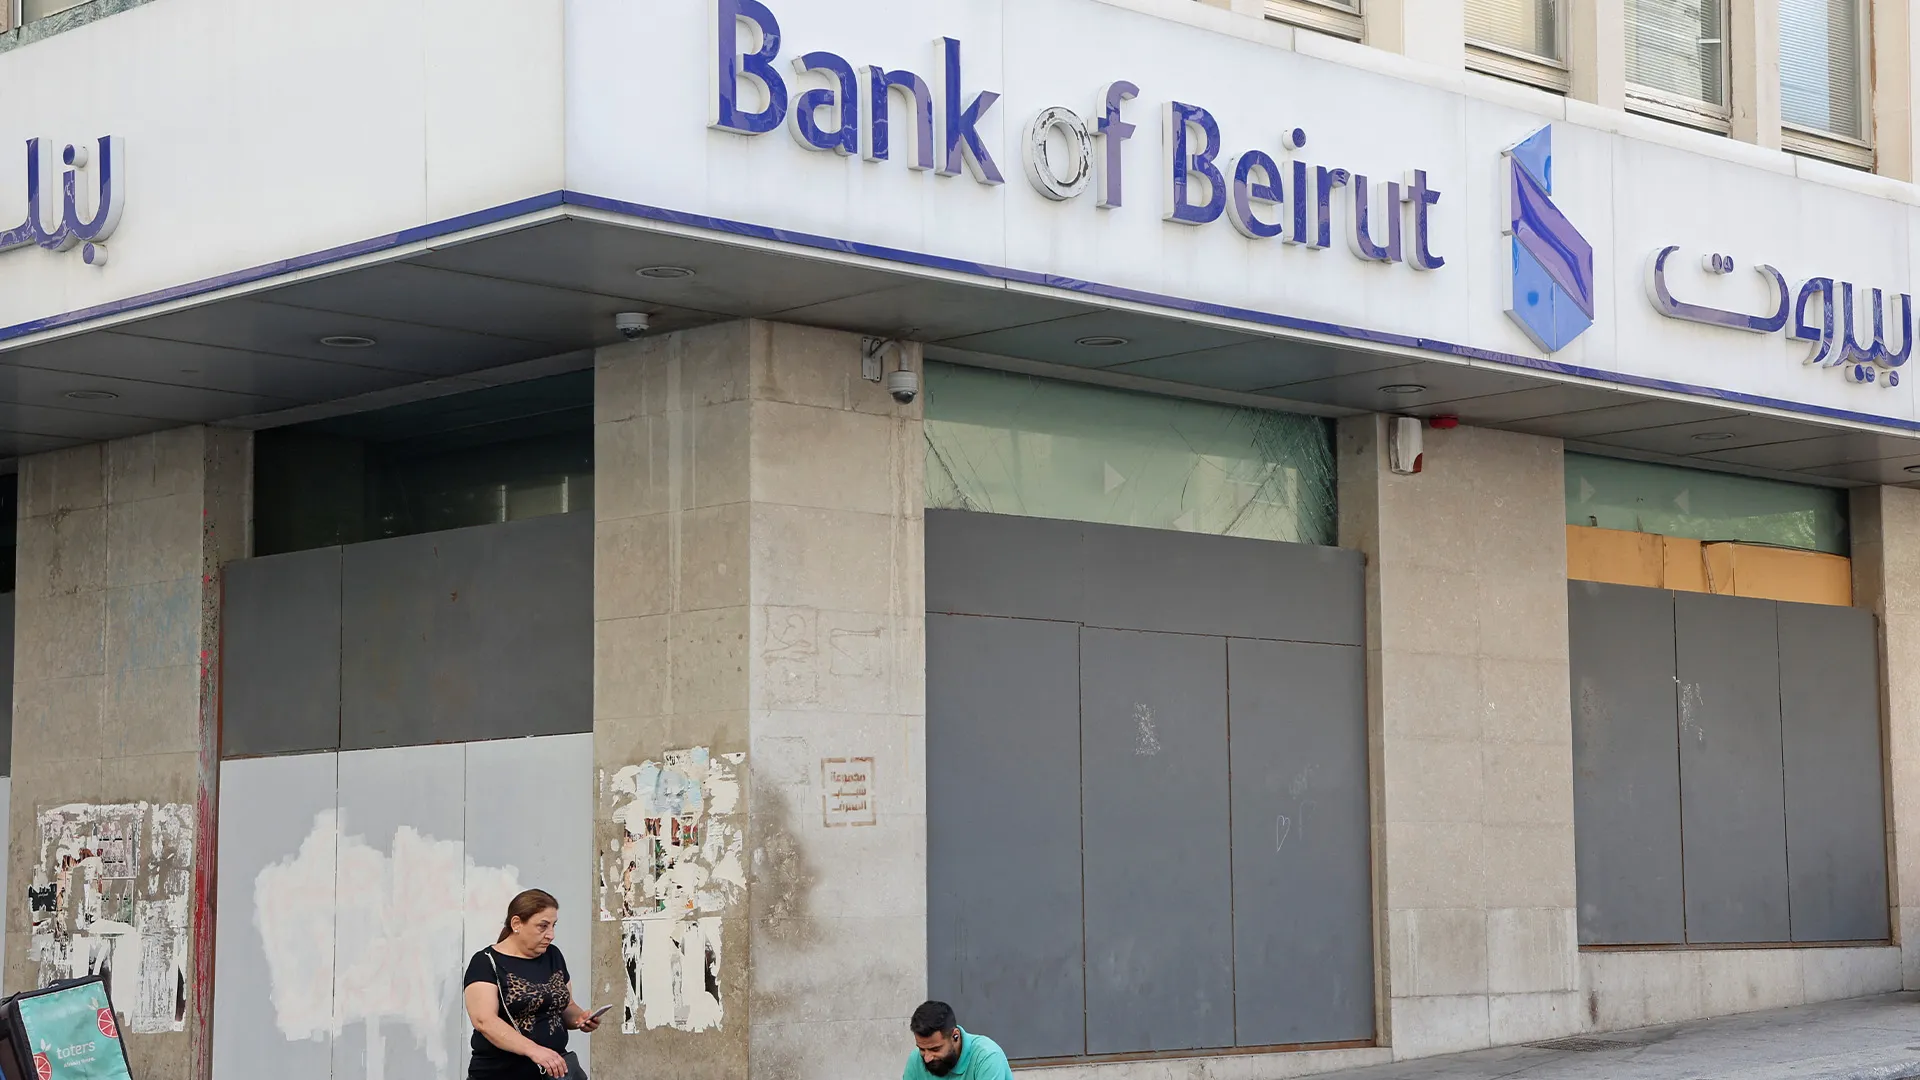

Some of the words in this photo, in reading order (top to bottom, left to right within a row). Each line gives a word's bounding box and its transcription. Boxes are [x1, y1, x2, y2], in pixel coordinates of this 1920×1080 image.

[708, 0, 1005, 187] Bank
[1022, 80, 1139, 210] of
[1162, 101, 1446, 272] Beirut
[1645, 245, 1912, 388] بيروت
[56, 1041, 96, 1060] toters
